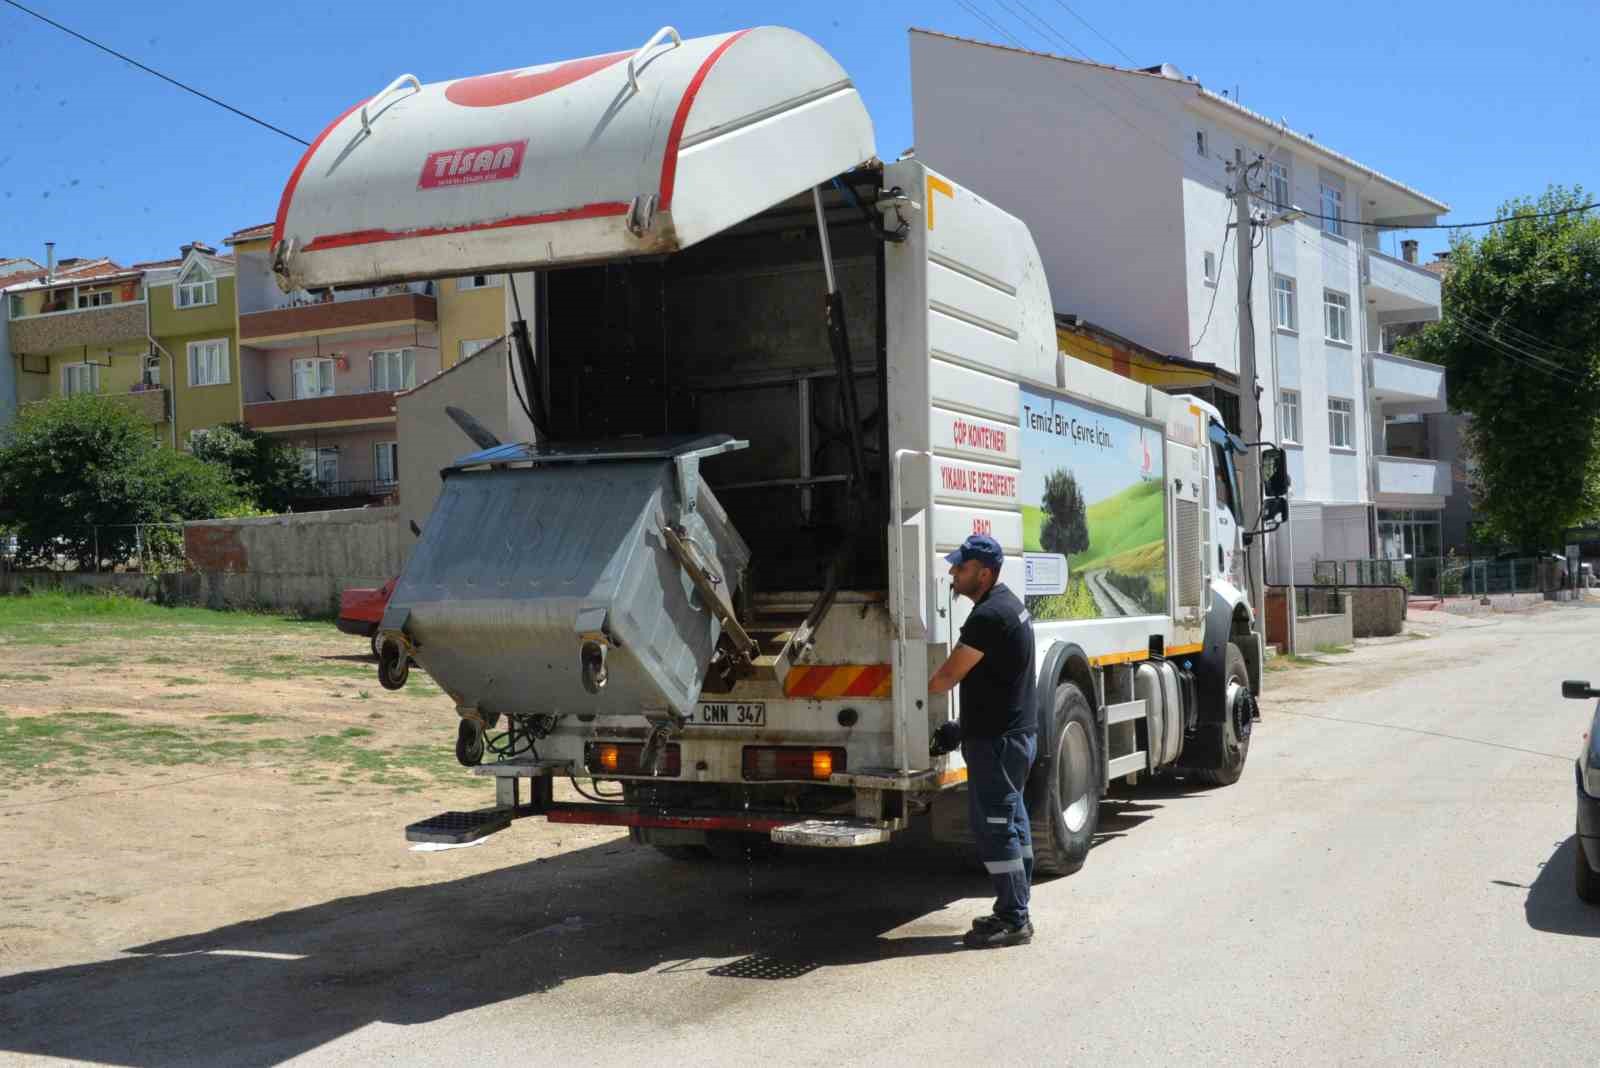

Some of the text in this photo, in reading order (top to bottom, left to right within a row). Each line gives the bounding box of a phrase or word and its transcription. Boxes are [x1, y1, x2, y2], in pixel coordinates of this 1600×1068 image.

[1023, 405, 1053, 433] Temiz
[1055, 414, 1069, 436] Bir
[1071, 418, 1095, 446] Çevre
[703, 705, 728, 722] CNN
[736, 705, 762, 723] 347
